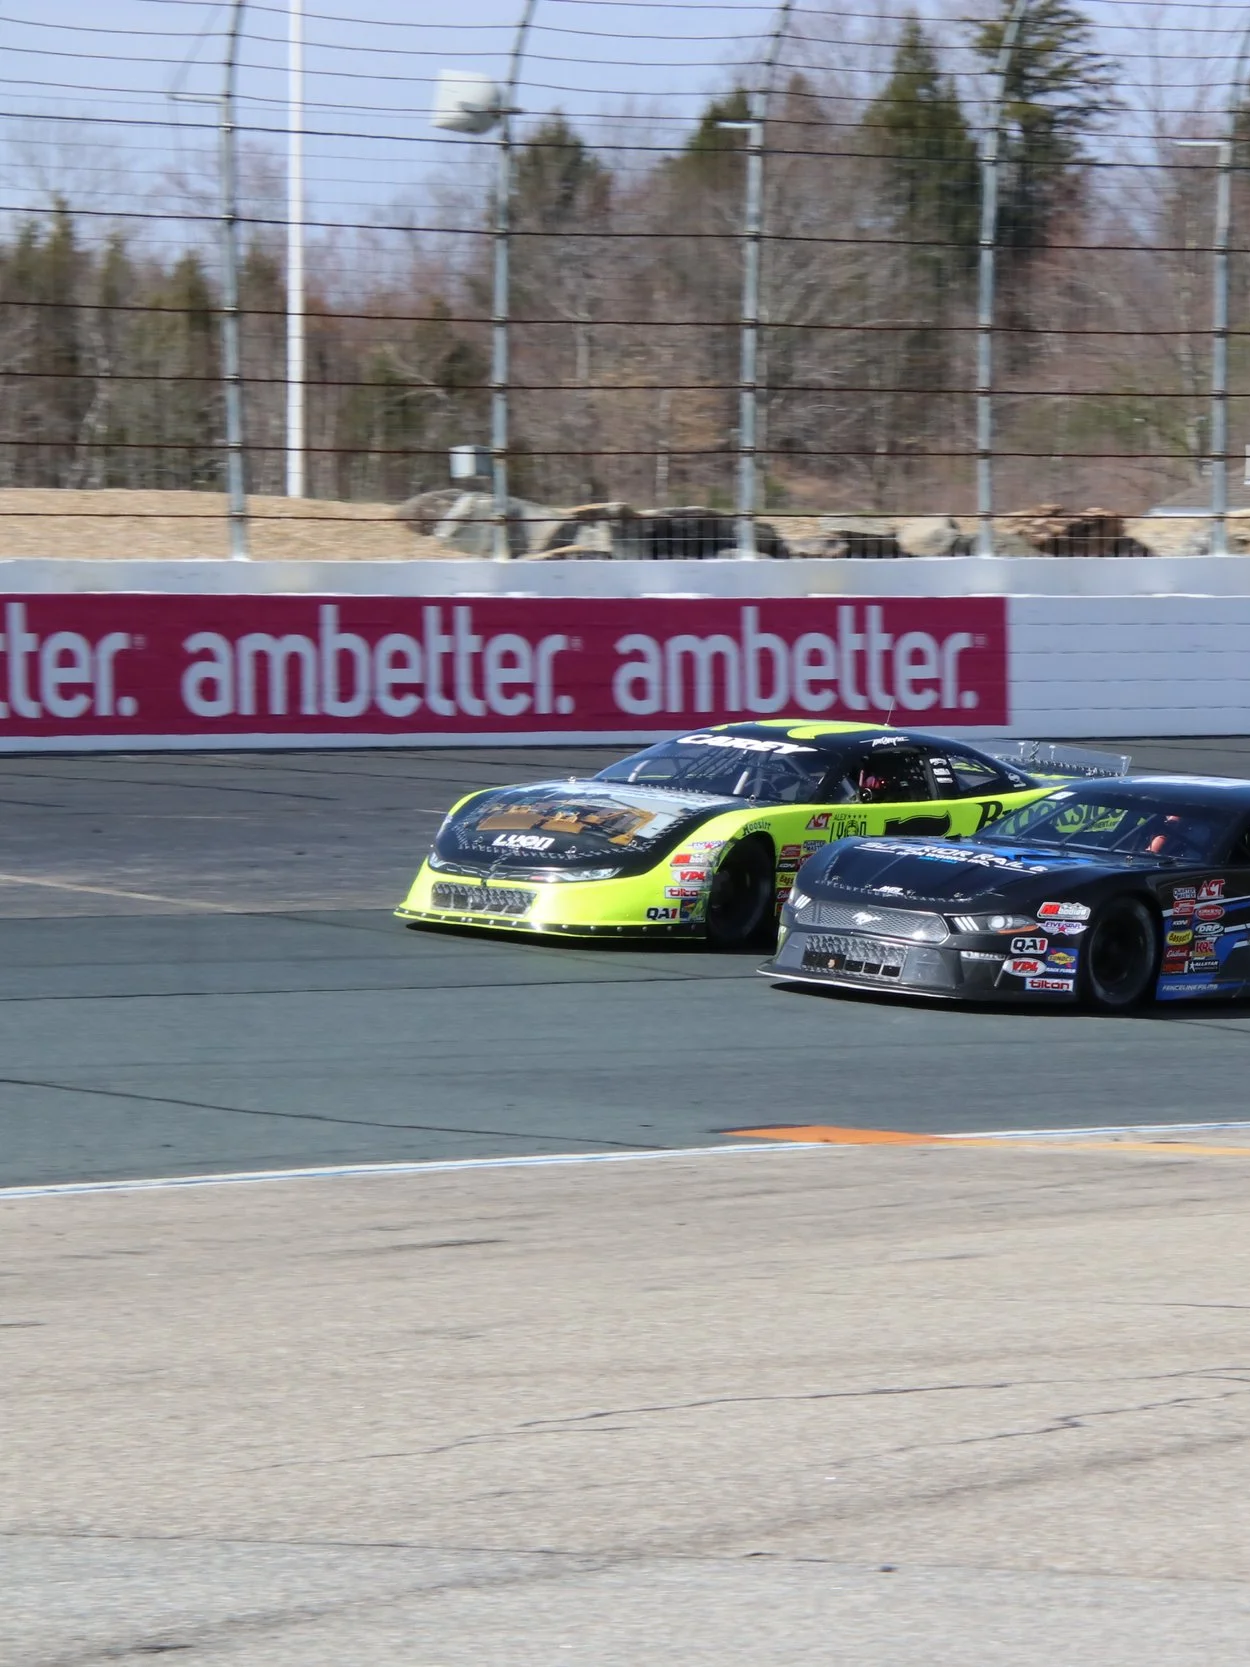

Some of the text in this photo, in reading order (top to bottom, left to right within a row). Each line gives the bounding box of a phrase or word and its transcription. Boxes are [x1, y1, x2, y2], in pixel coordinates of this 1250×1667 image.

[676, 734, 819, 754] CAREY
[979, 853, 1024, 871] RAIL
[1197, 879, 1225, 899] ACT
[646, 907, 678, 920] QA1
[1013, 939, 1046, 952] QA1
[1029, 979, 1070, 990] tilton
